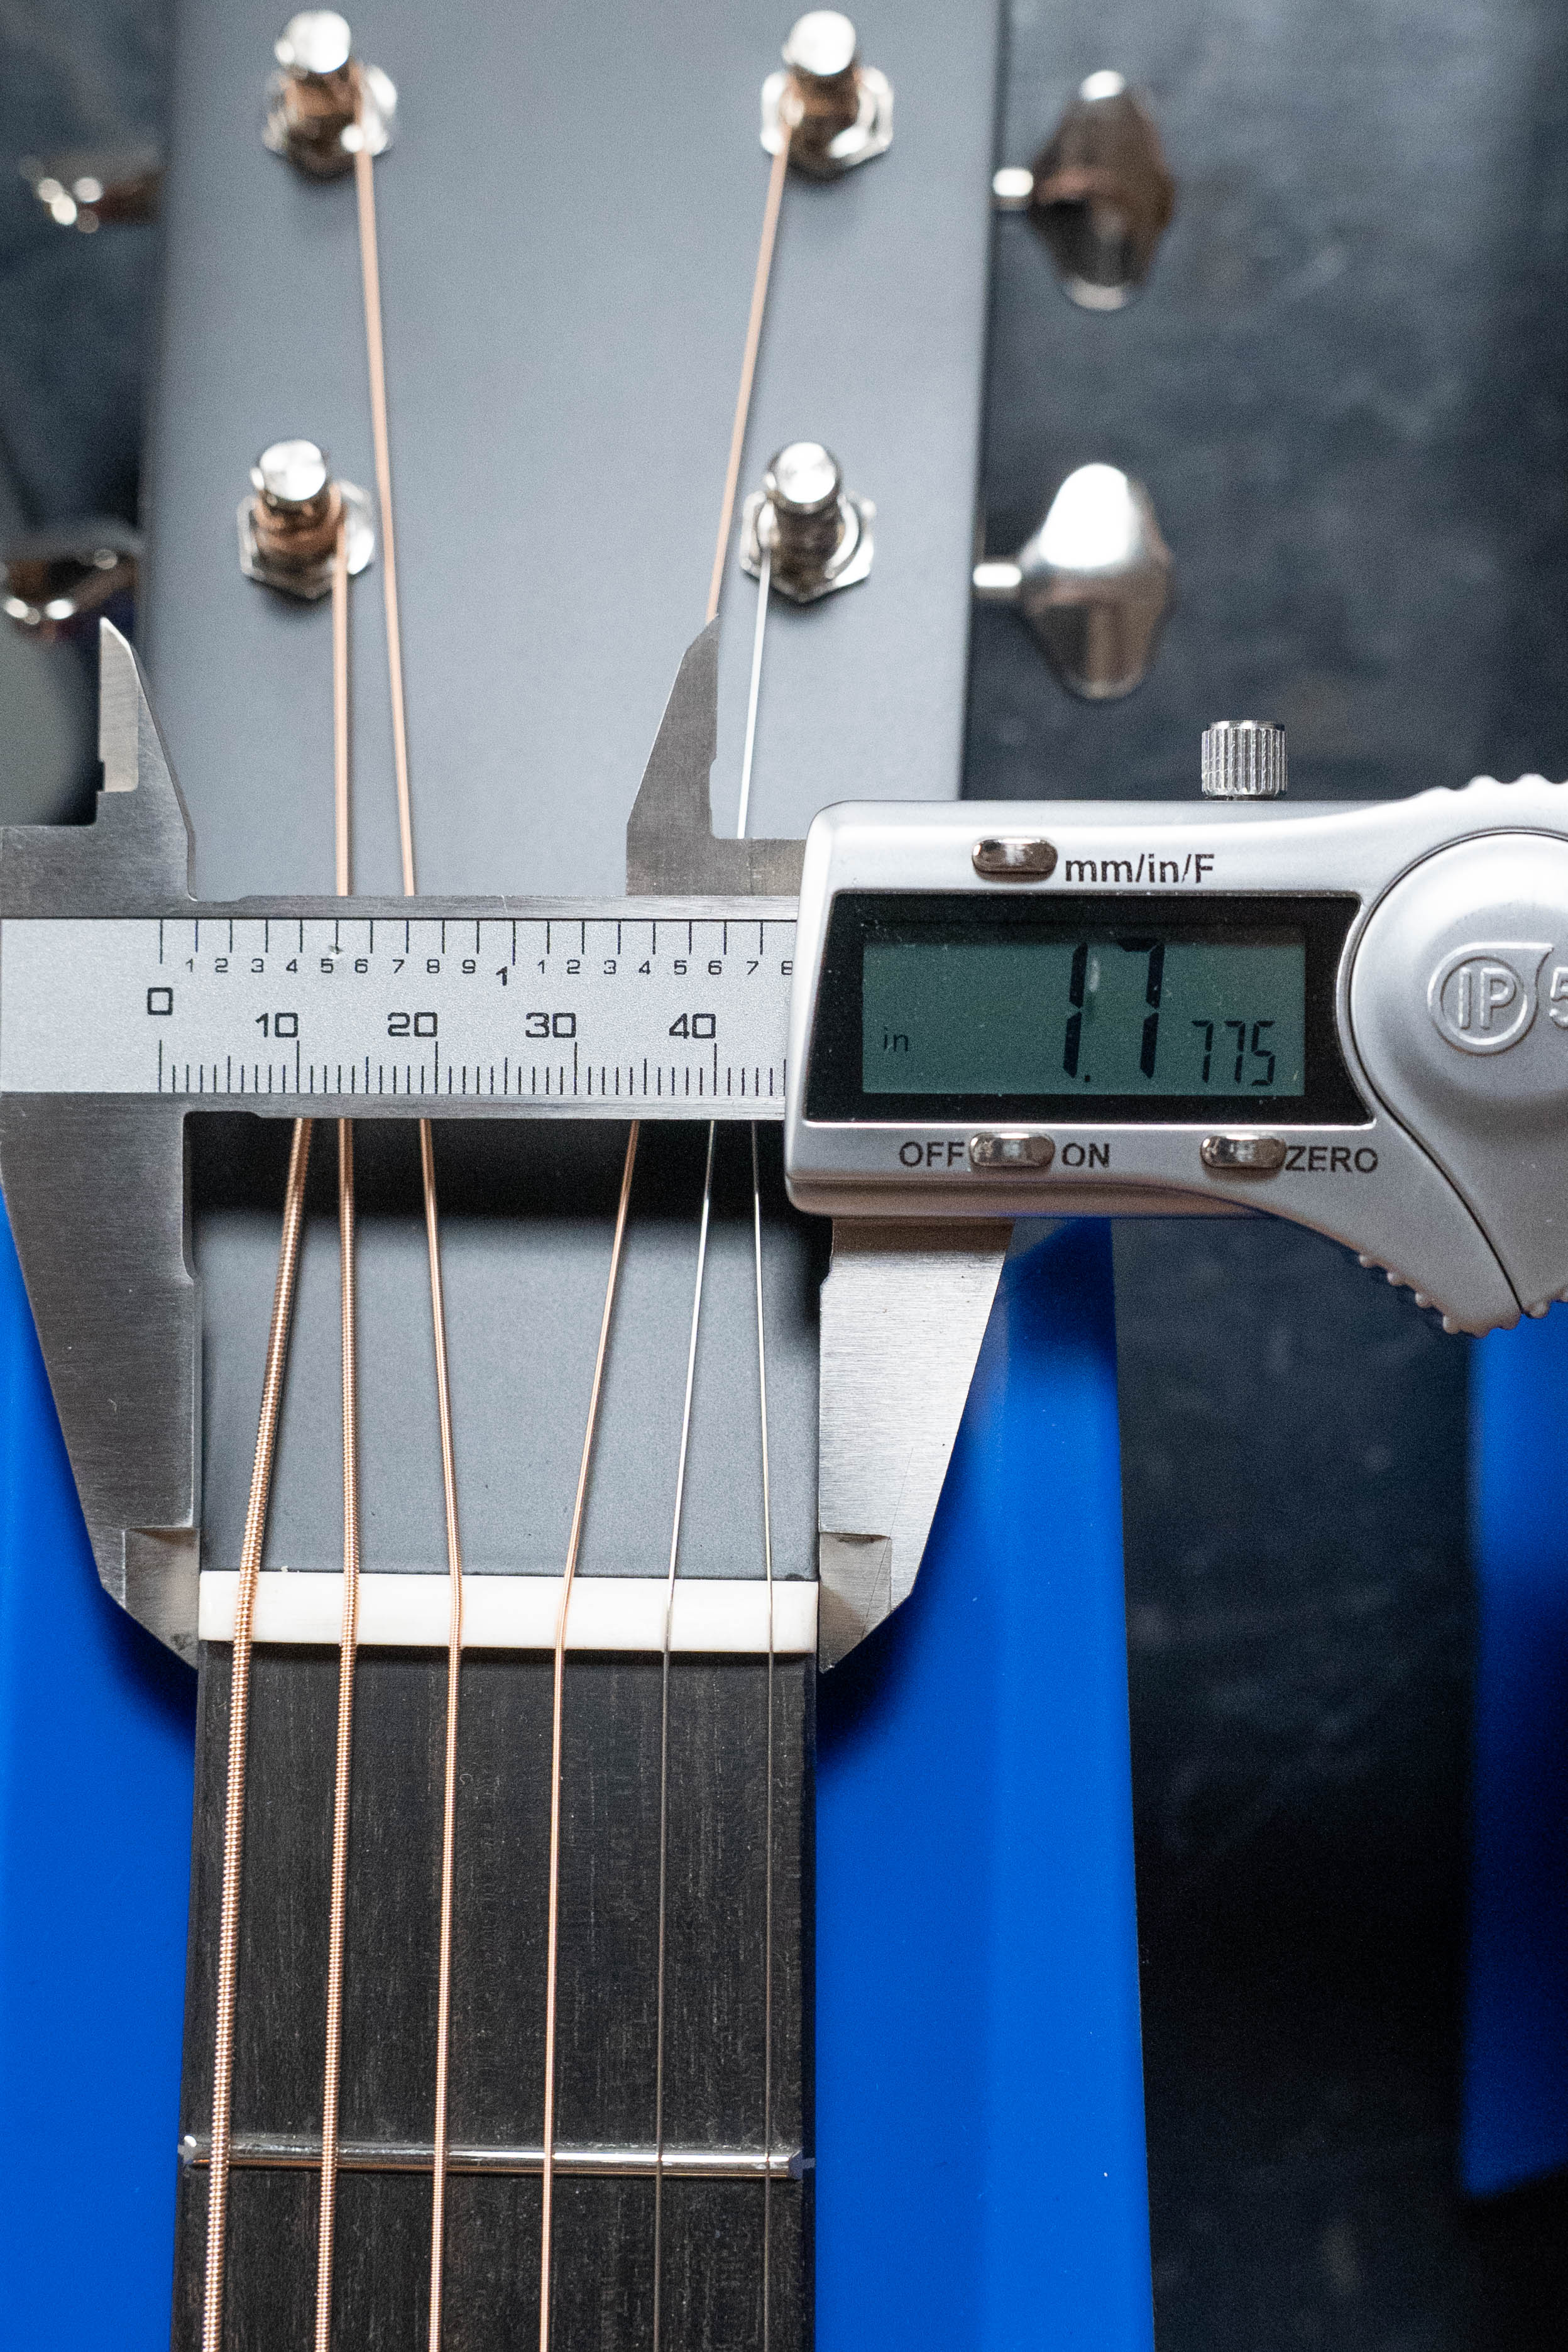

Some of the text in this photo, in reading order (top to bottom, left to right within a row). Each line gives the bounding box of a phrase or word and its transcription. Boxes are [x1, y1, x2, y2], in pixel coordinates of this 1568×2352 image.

[1065, 853, 1214, 883] mm/in/F
[185, 959, 194, 972] 1
[215, 958, 229, 973] 2
[251, 958, 264, 973] 3
[285, 959, 299, 974] 4
[321, 958, 334, 974] 5
[354, 958, 368, 974] 6
[392, 959, 405, 974] 7
[426, 959, 441, 974] 8
[462, 959, 476, 974] 9
[495, 965, 508, 986] 1
[537, 960, 546, 974] 1
[566, 959, 581, 975] 2
[603, 959, 617, 975] 3
[638, 960, 651, 975] 4
[674, 960, 688, 975] 5
[708, 960, 722, 975] 6
[746, 960, 760, 975] 7
[146, 987, 173, 1016] 0
[1458, 966, 1516, 1030] IP
[255, 1012, 716, 1039] 10 20 30 40
[883, 1027, 910, 1052] in
[899, 1141, 1379, 1173] OFF ON ZERO
